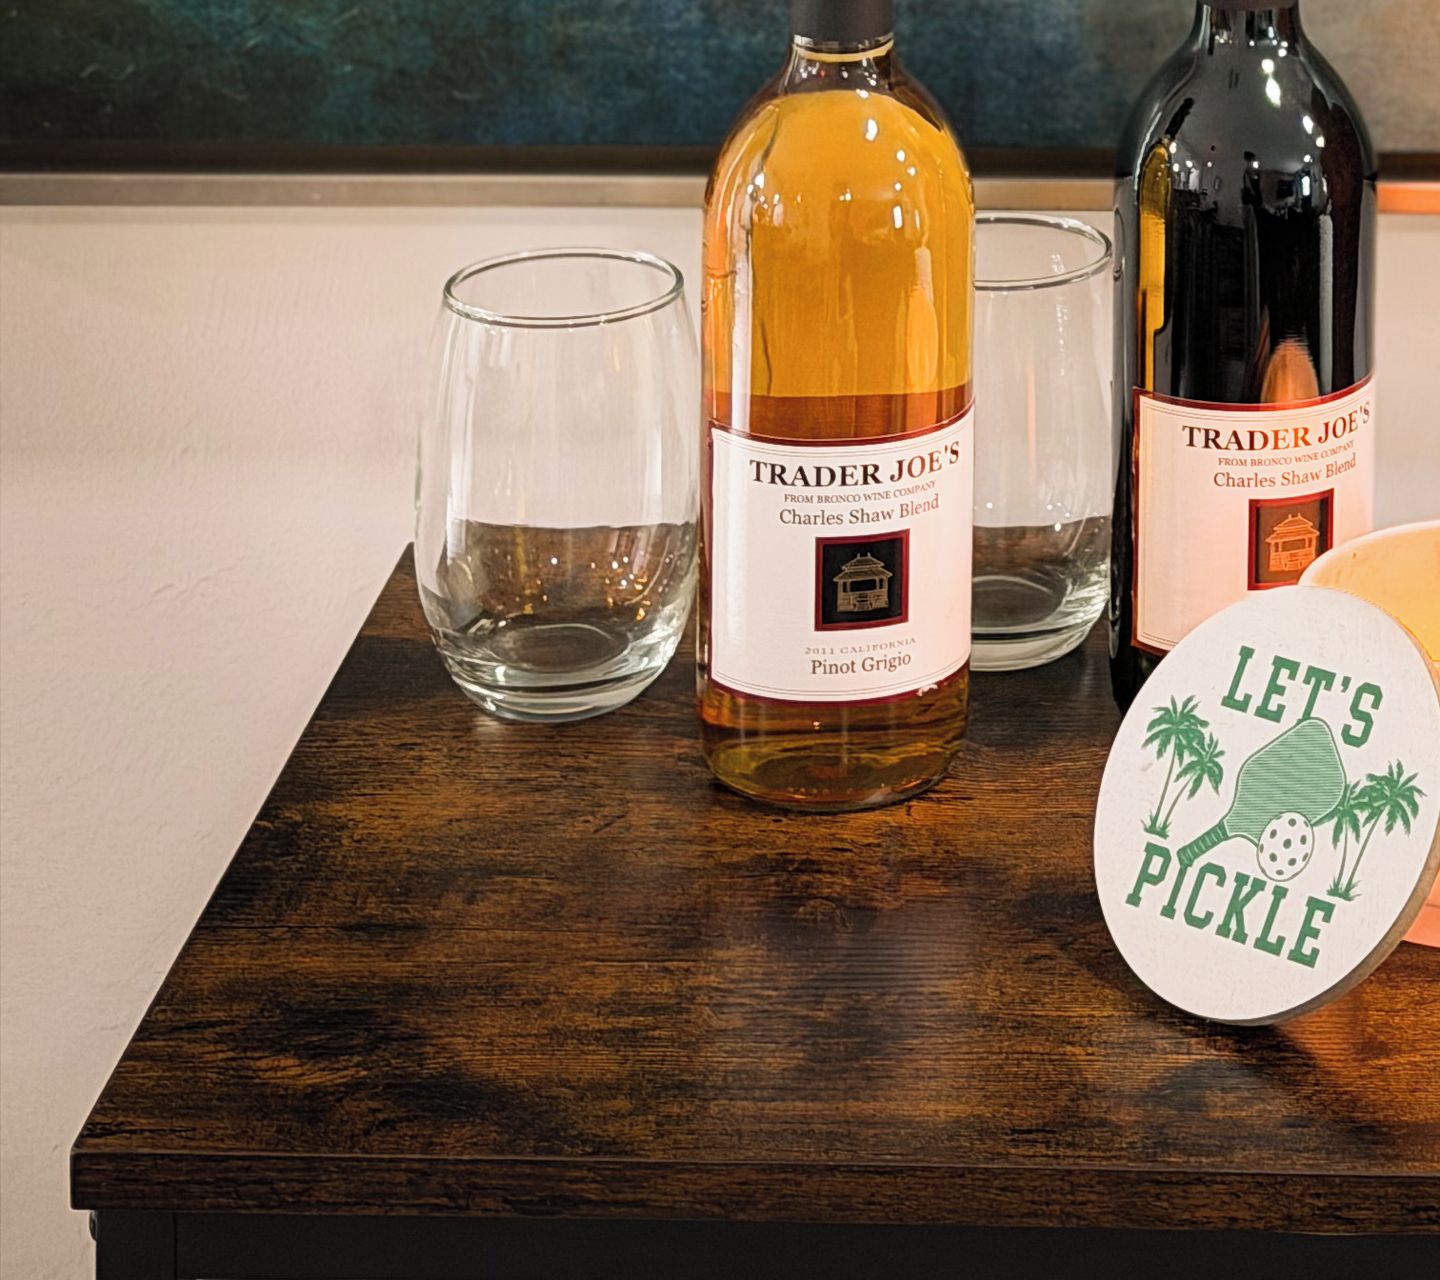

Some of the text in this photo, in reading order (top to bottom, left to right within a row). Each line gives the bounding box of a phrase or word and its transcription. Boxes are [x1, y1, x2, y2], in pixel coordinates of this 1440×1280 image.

[1182, 401, 1370, 451] TRADER JOE'S
[749, 440, 960, 487] TRADER JOE'S
[1213, 451, 1356, 488] Charles Shaw Blend
[1218, 439, 1354, 468] FROM BRONCO WINE COMPANY
[779, 492, 940, 525] Charles Shaw Blend
[784, 479, 936, 504] FROM BRONCO WINE COMPANY
[810, 651, 911, 675] Pinot Grigio
[840, 637, 916, 654] CALIFORNIA
[1221, 645, 1383, 748] LET'S
[1125, 842, 1336, 968] PICKLE
